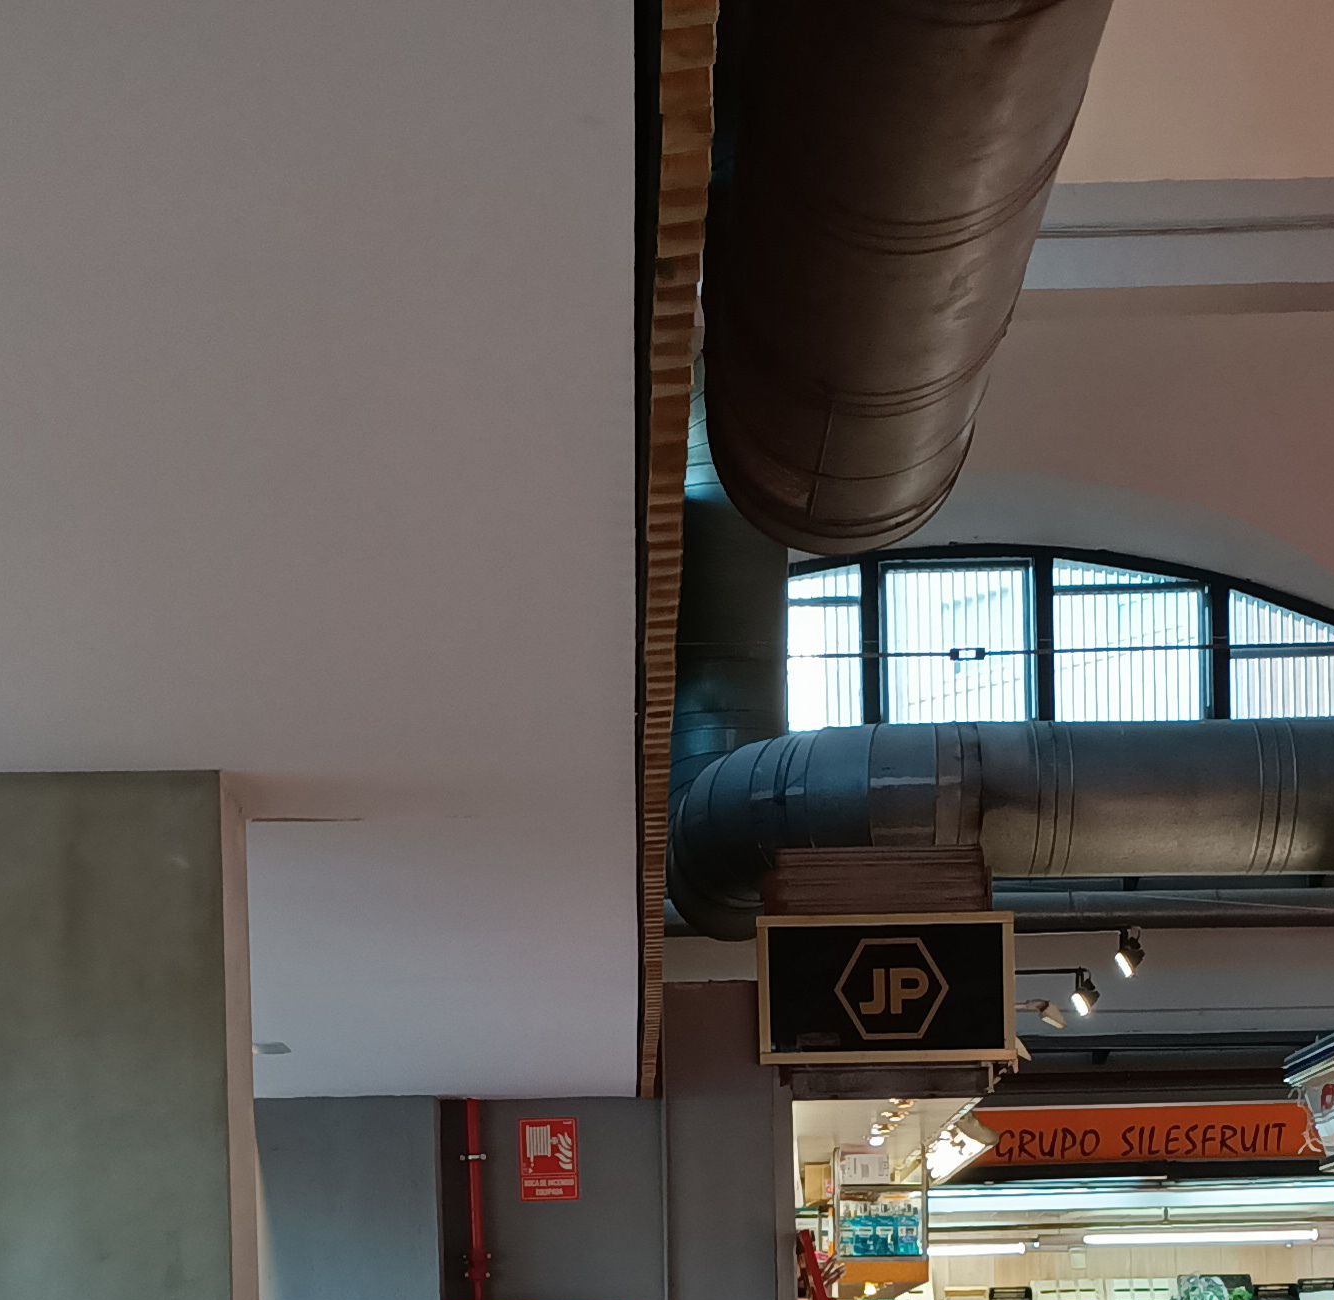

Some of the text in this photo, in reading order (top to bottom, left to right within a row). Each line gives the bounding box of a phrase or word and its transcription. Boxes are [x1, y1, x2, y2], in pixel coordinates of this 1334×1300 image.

[859, 967, 930, 1015] JP
[995, 1122, 1287, 1162] GRUPO SILESFRUIT
